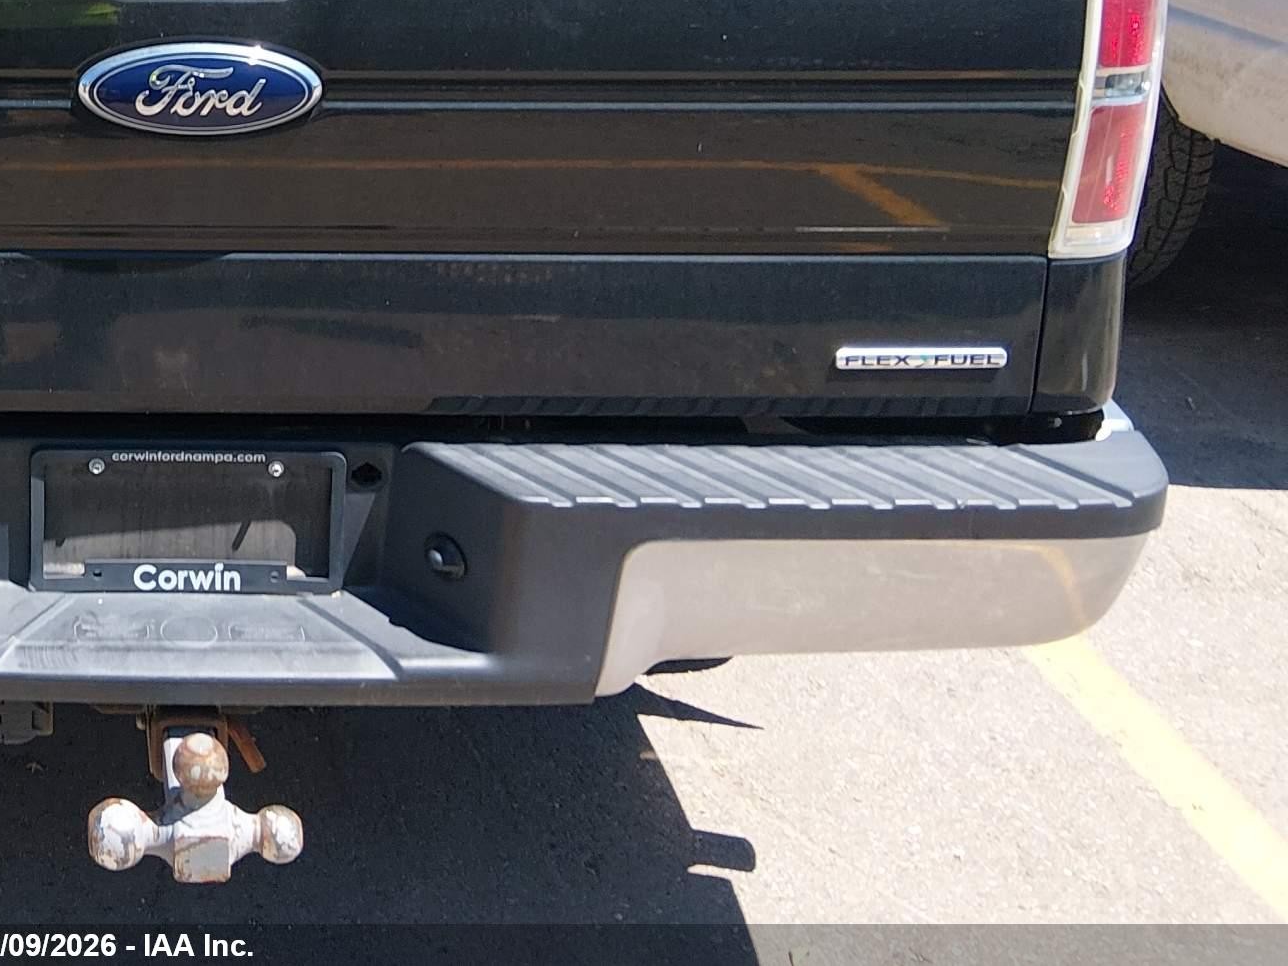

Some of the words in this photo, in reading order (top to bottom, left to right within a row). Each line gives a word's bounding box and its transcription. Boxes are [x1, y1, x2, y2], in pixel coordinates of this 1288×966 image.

[135, 63, 267, 118] Ford
[844, 354, 910, 367] FLEX
[934, 353, 1000, 366] FUEL
[112, 450, 267, 464] corwinfordnampa.com
[133, 562, 241, 592] Corwin
